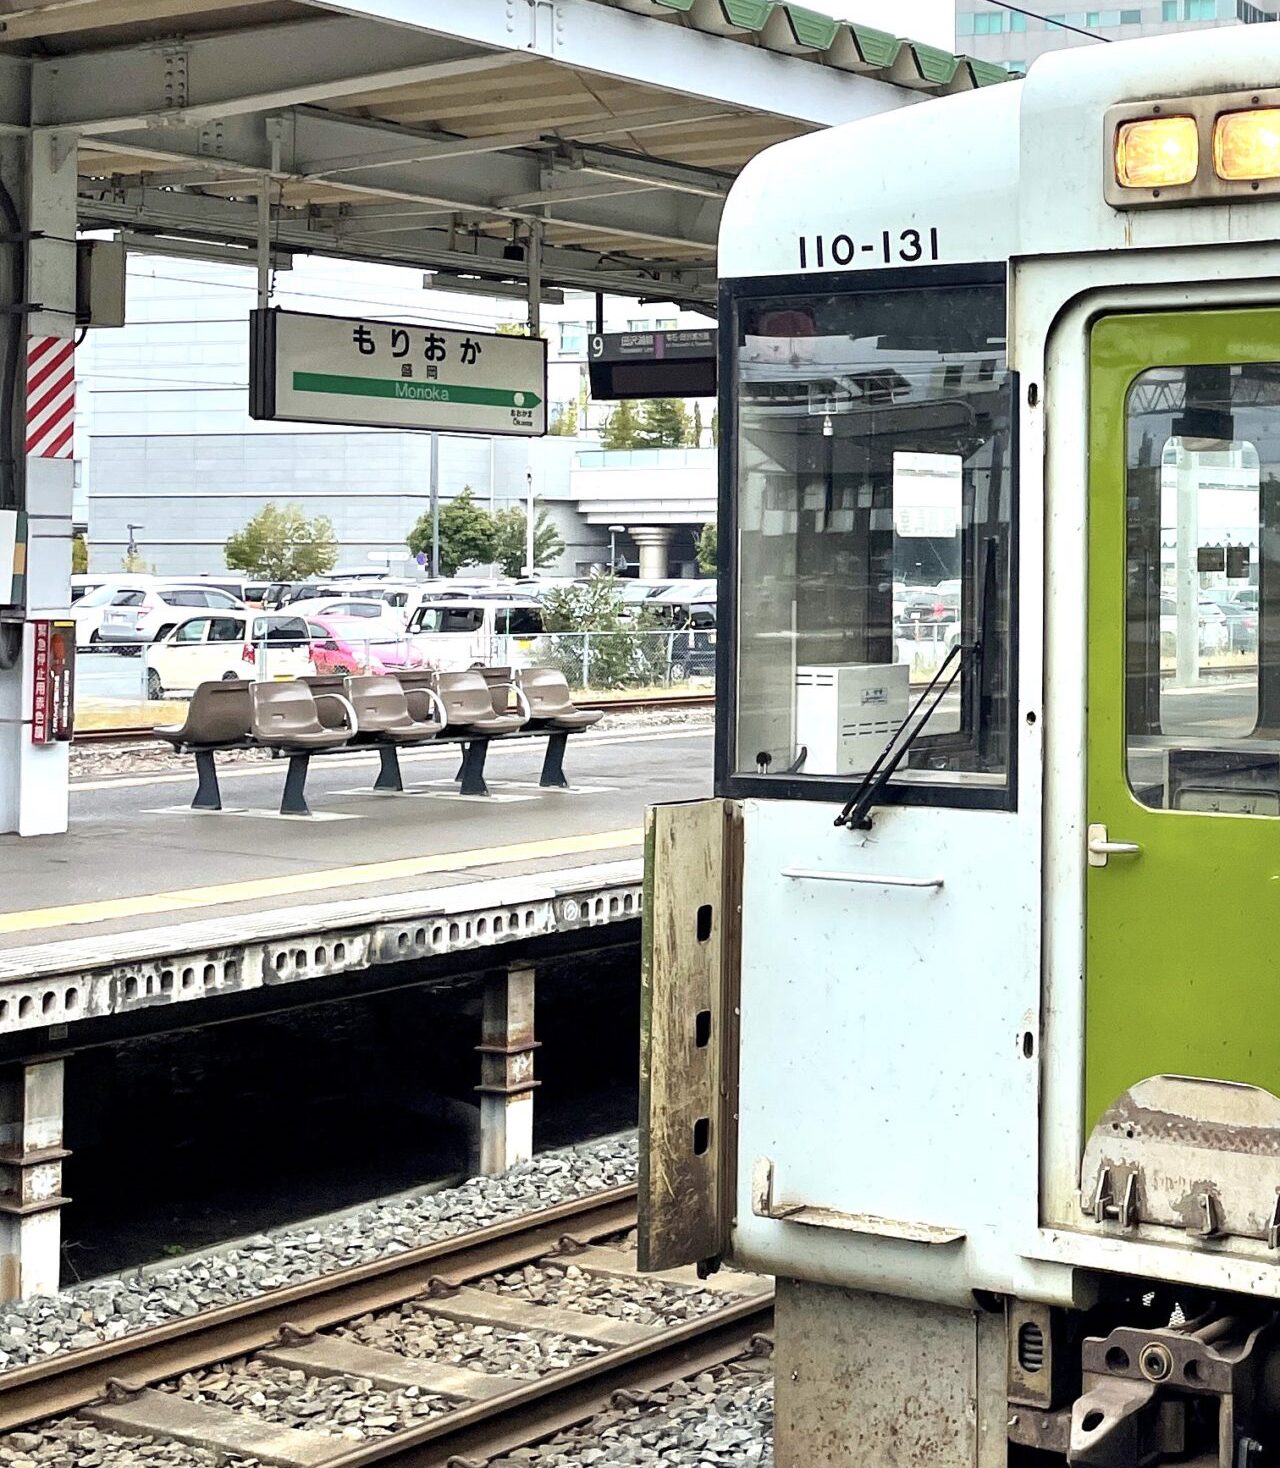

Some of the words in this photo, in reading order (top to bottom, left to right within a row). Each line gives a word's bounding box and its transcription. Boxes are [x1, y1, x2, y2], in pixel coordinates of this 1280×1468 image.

[800, 227, 938, 268] 110-131
[352, 324, 482, 365] もりおか
[592, 336, 604, 358] 9
[395, 382, 449, 401] Morioka
